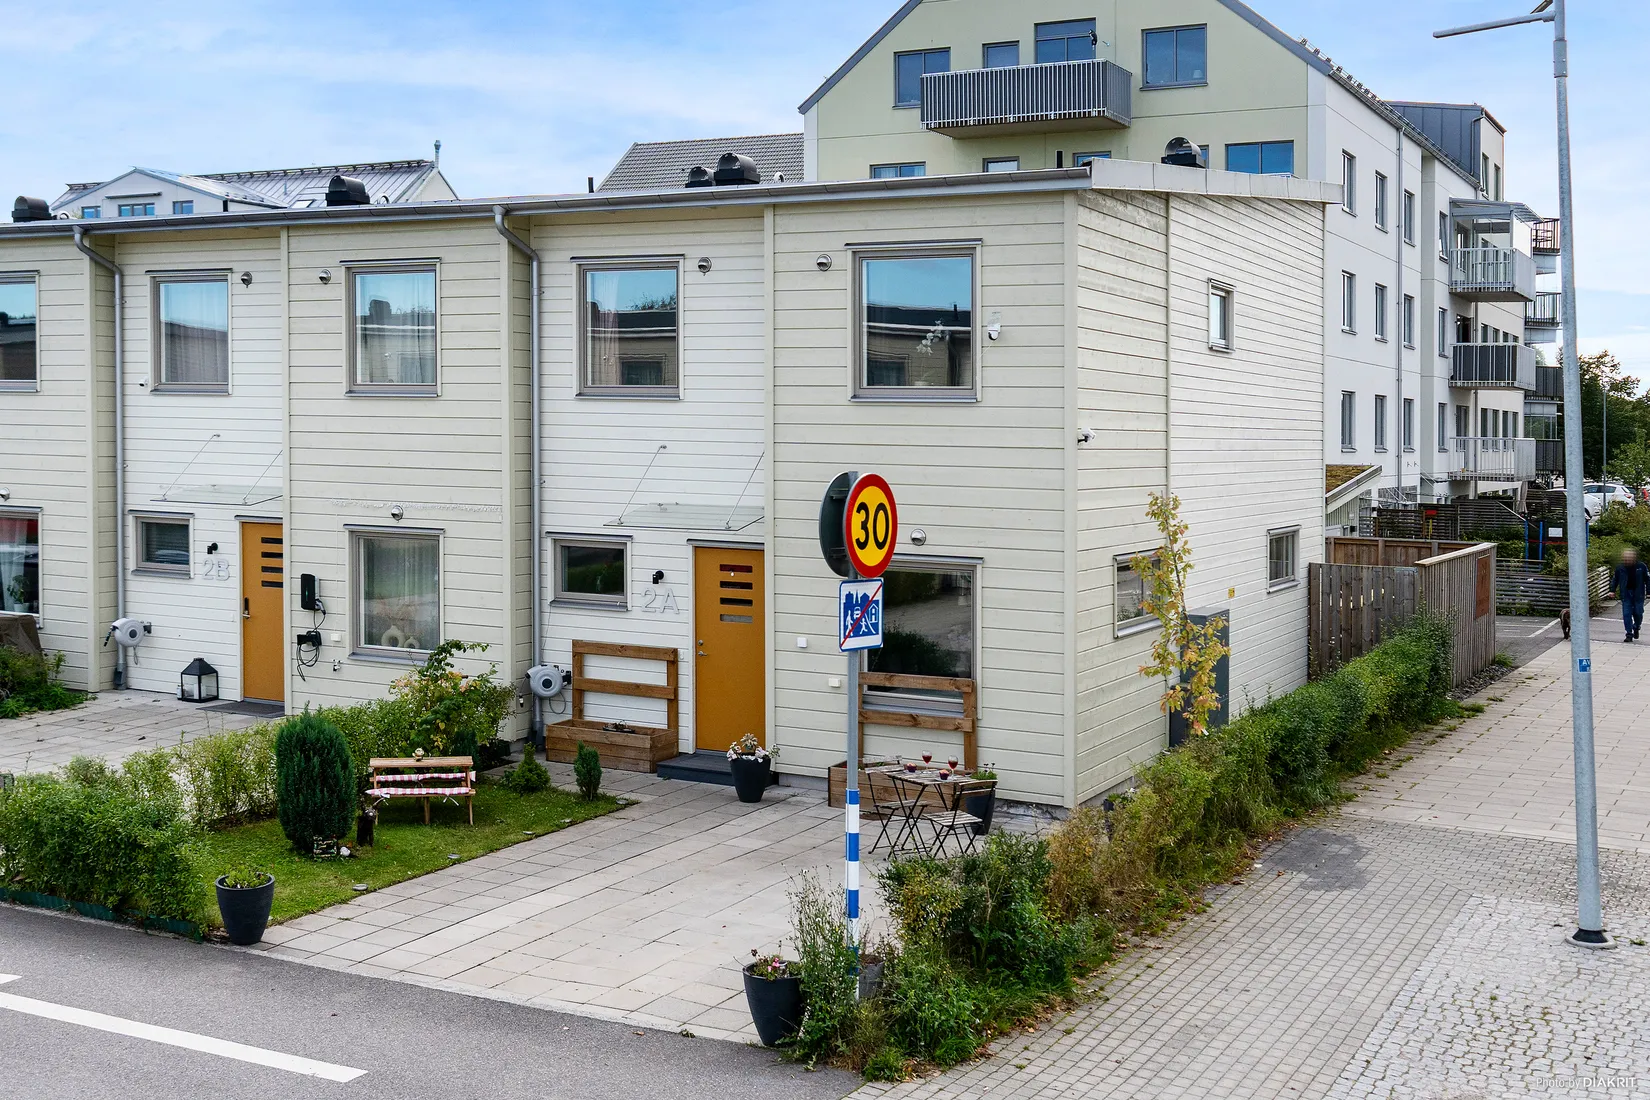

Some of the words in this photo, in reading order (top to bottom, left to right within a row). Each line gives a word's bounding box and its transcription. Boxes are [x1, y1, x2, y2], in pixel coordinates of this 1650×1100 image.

[855, 501, 890, 550] 30
[203, 558, 230, 581] 2B
[641, 587, 680, 615] 2A
